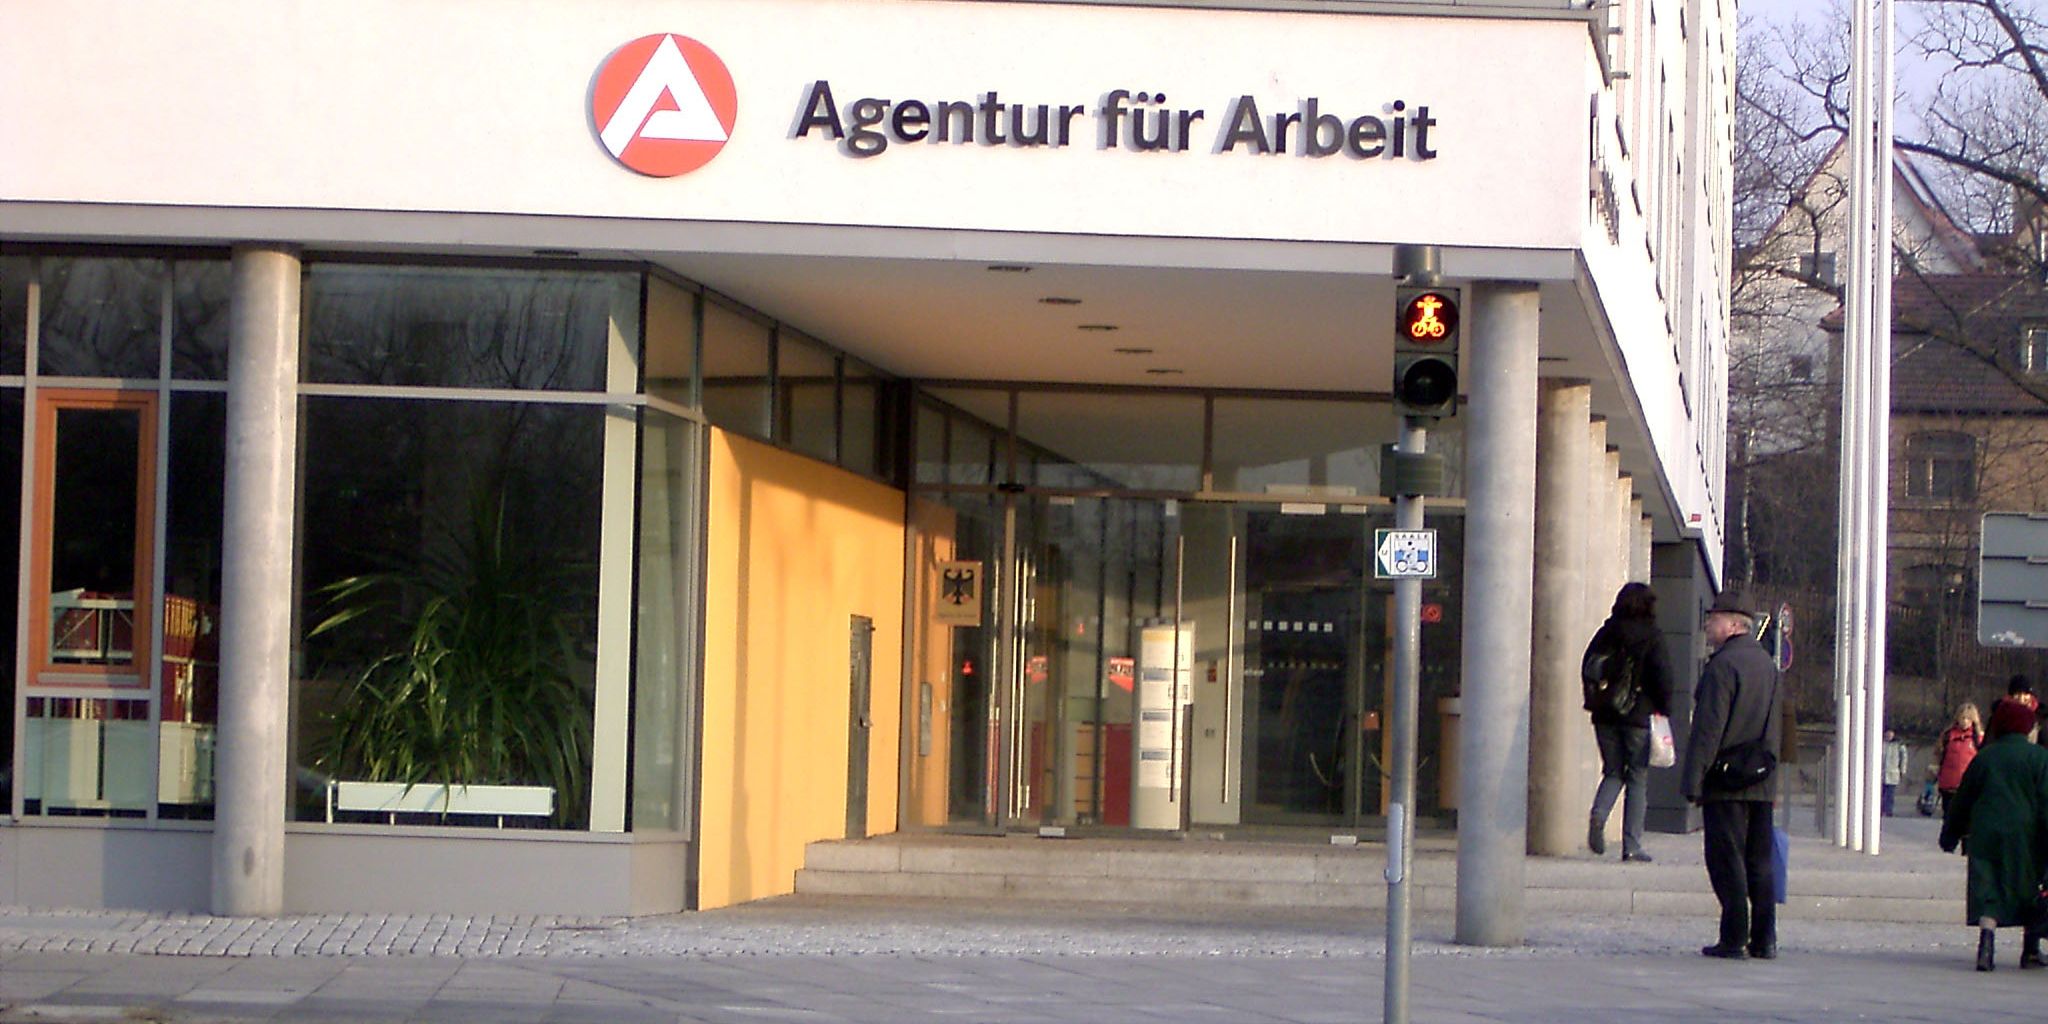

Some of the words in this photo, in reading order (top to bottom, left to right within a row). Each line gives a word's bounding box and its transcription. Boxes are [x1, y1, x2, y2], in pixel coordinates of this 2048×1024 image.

[795, 80, 1085, 157] Agentur
[1102, 89, 1204, 149] für
[1221, 95, 1437, 159] Arbeit
